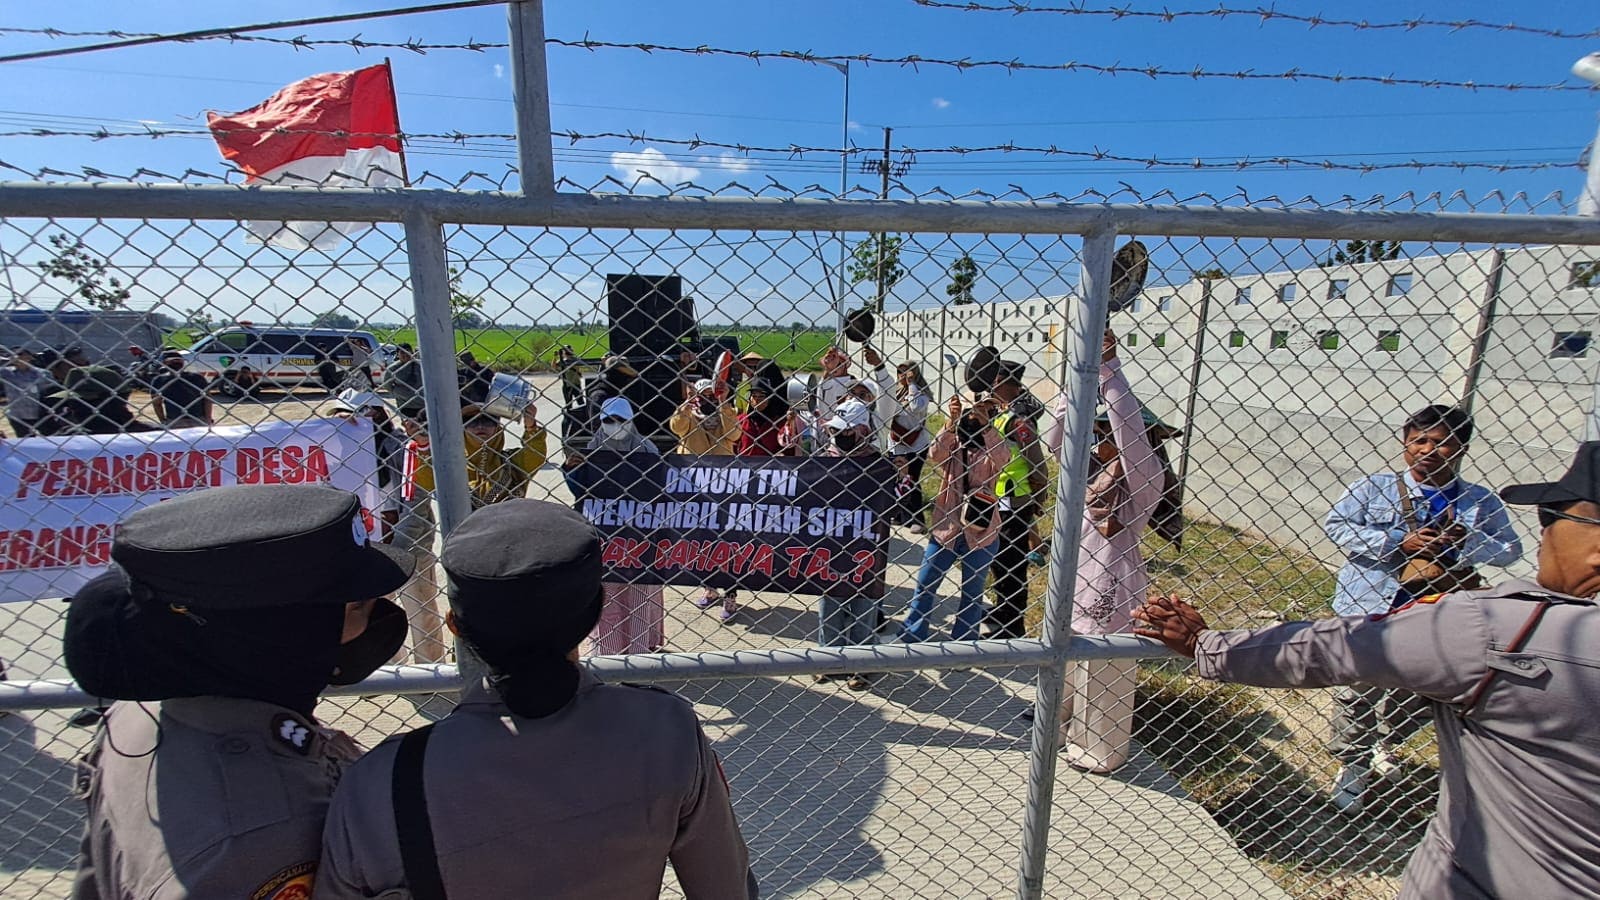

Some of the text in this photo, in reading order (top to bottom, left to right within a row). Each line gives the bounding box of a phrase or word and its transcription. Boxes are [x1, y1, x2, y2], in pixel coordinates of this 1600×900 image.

[16, 445, 331, 499] PERANGKAT DESA
[665, 466, 798, 497] OKNUM TNI
[582, 498, 881, 542] MENGAMBIL JATAH SIPIL,
[0, 522, 121, 572] RANG
[600, 536, 650, 570] AK
